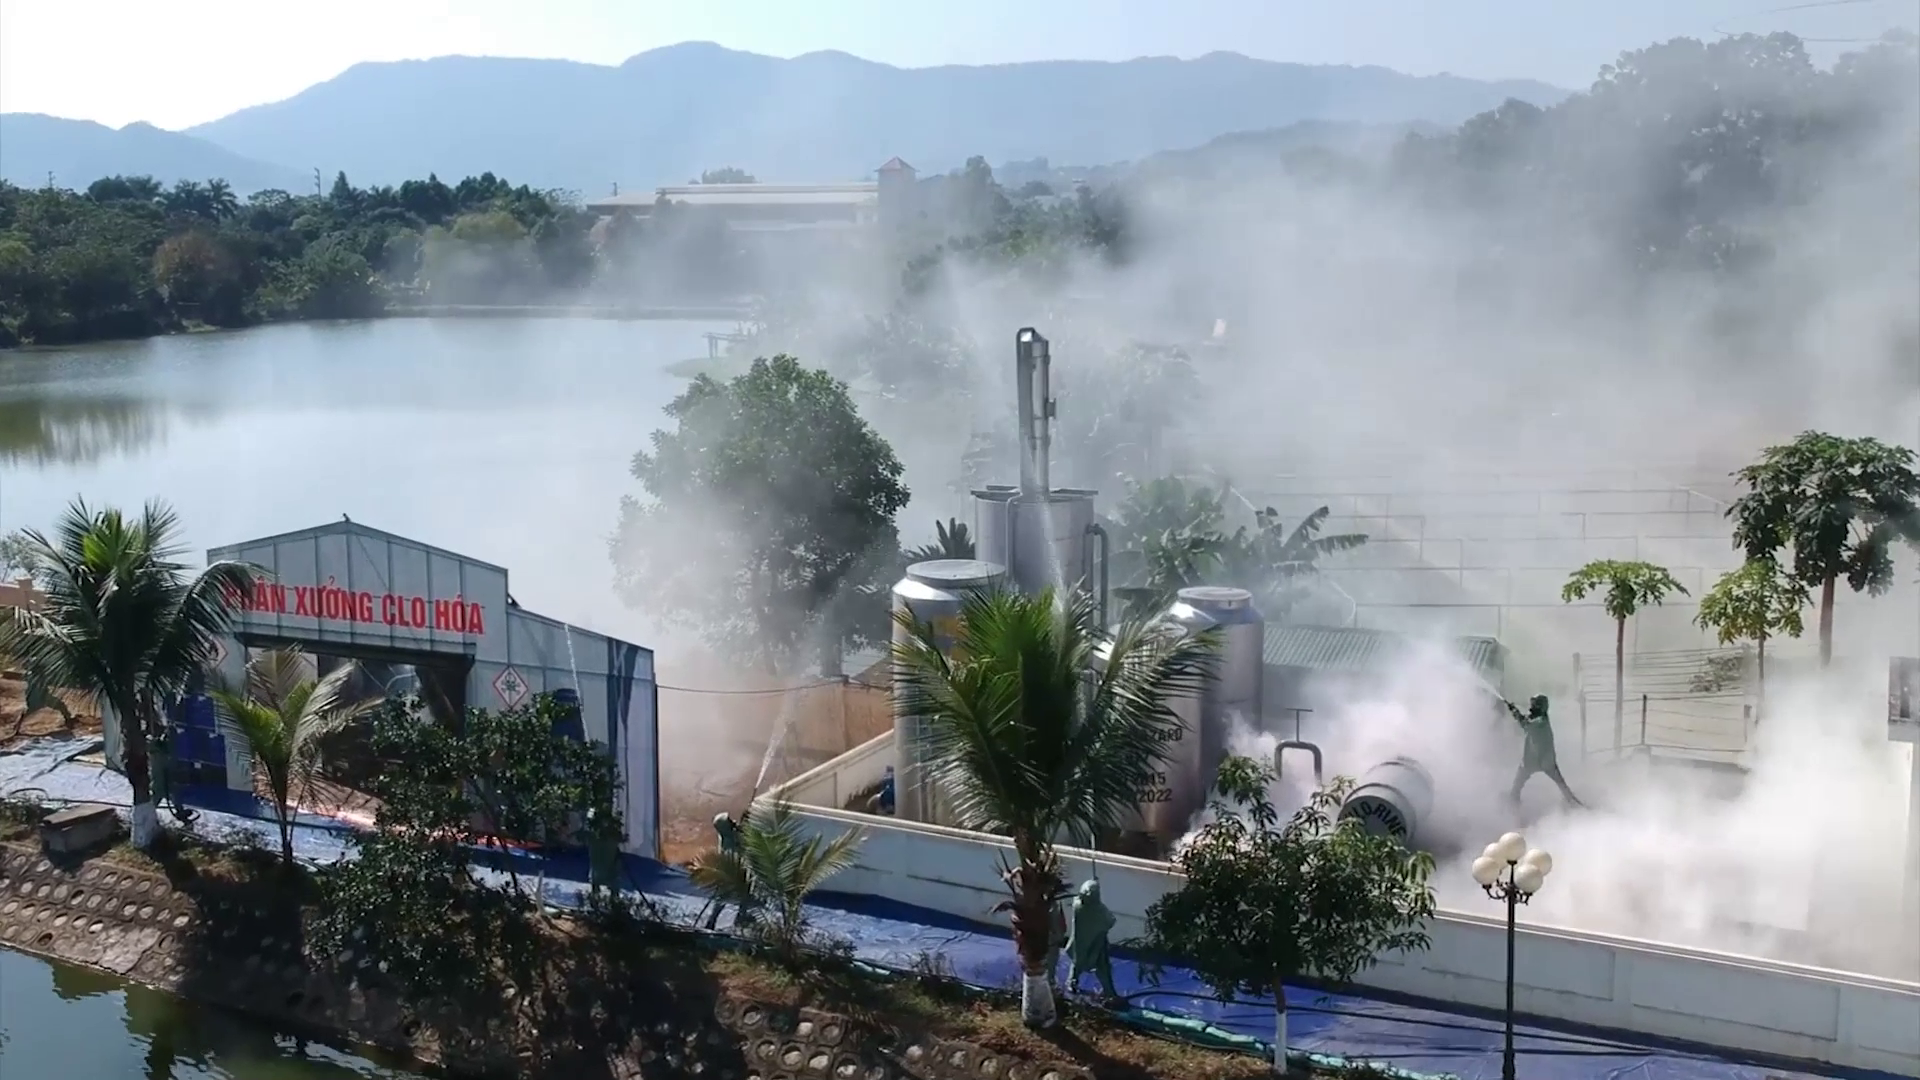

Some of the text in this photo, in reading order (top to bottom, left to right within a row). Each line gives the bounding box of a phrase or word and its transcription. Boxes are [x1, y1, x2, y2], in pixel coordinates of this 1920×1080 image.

[294, 575, 374, 623] XƯỞNG
[382, 593, 426, 629] CLO
[435, 593, 484, 635] HÓA
